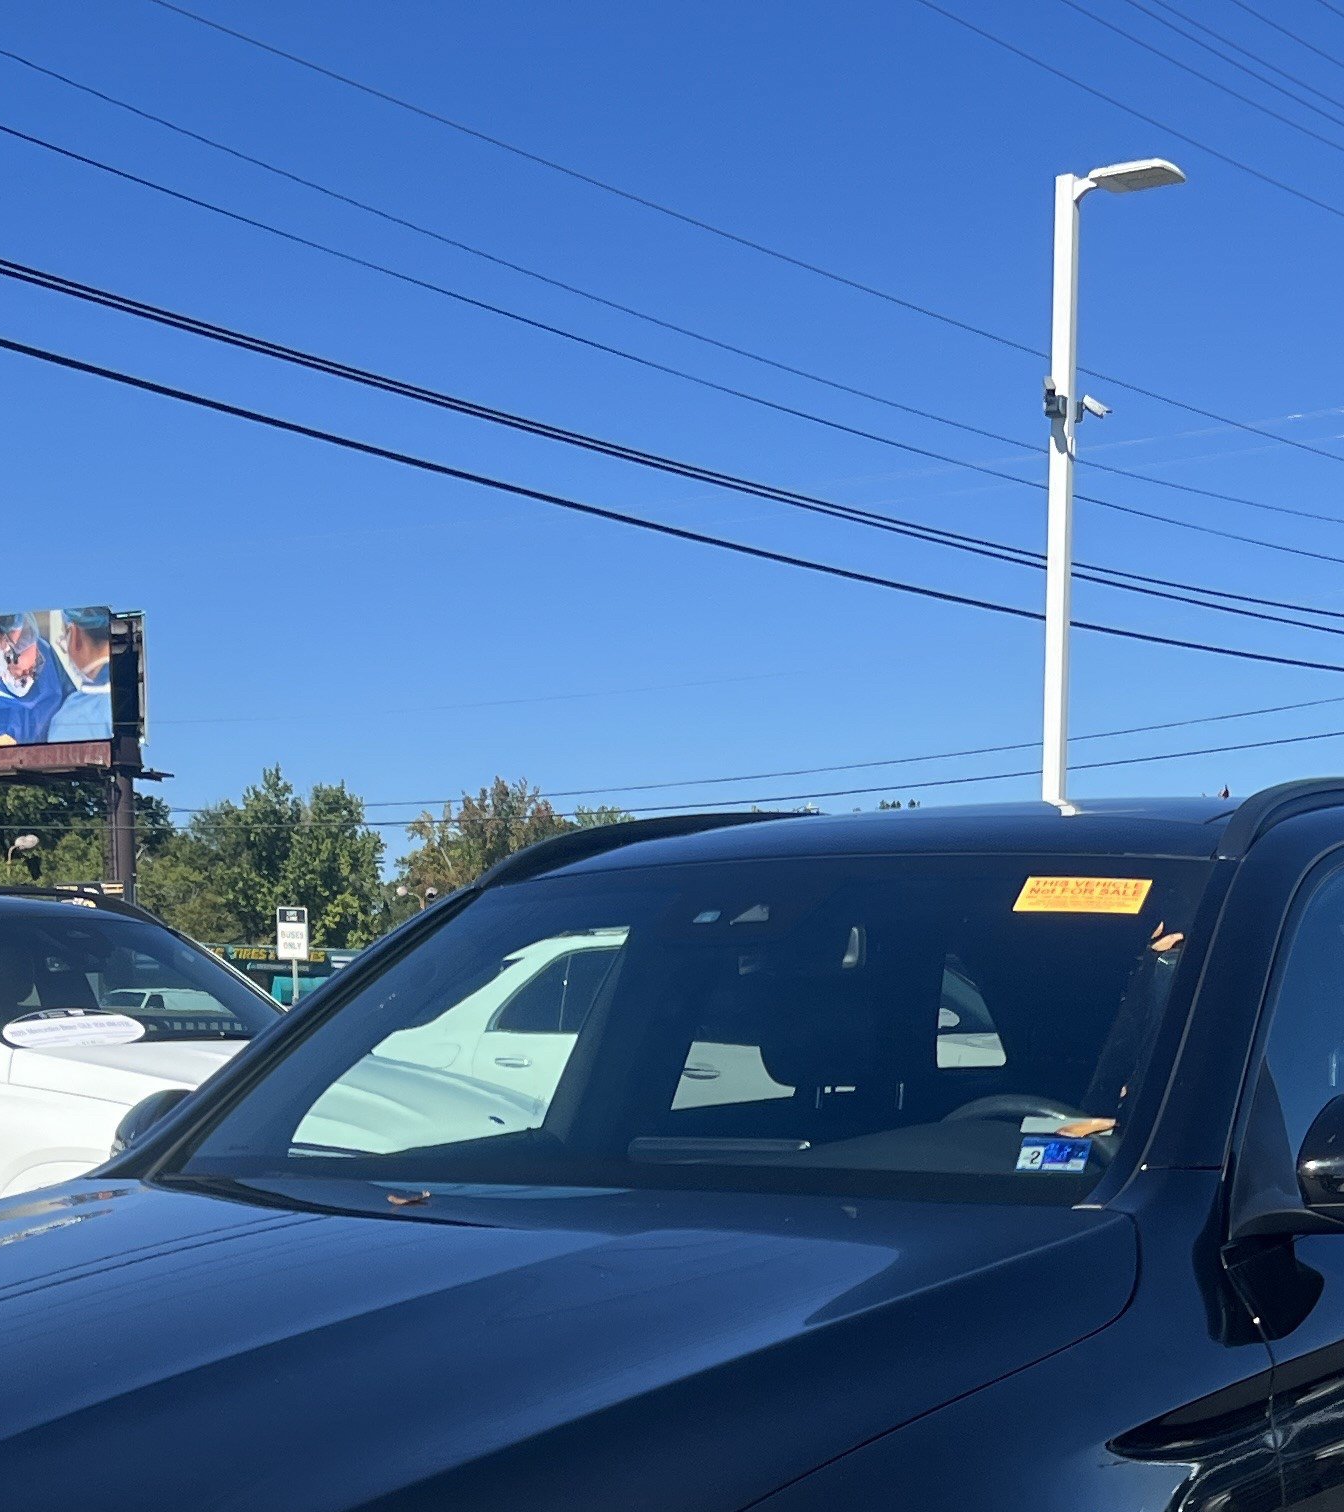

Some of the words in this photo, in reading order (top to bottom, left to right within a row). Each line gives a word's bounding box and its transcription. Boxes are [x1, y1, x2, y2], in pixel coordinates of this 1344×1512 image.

[1076, 880, 1144, 889] VEHICLE
[1099, 888, 1143, 897] SALE
[280, 931, 304, 940] BUSES
[283, 941, 302, 950] ONLY
